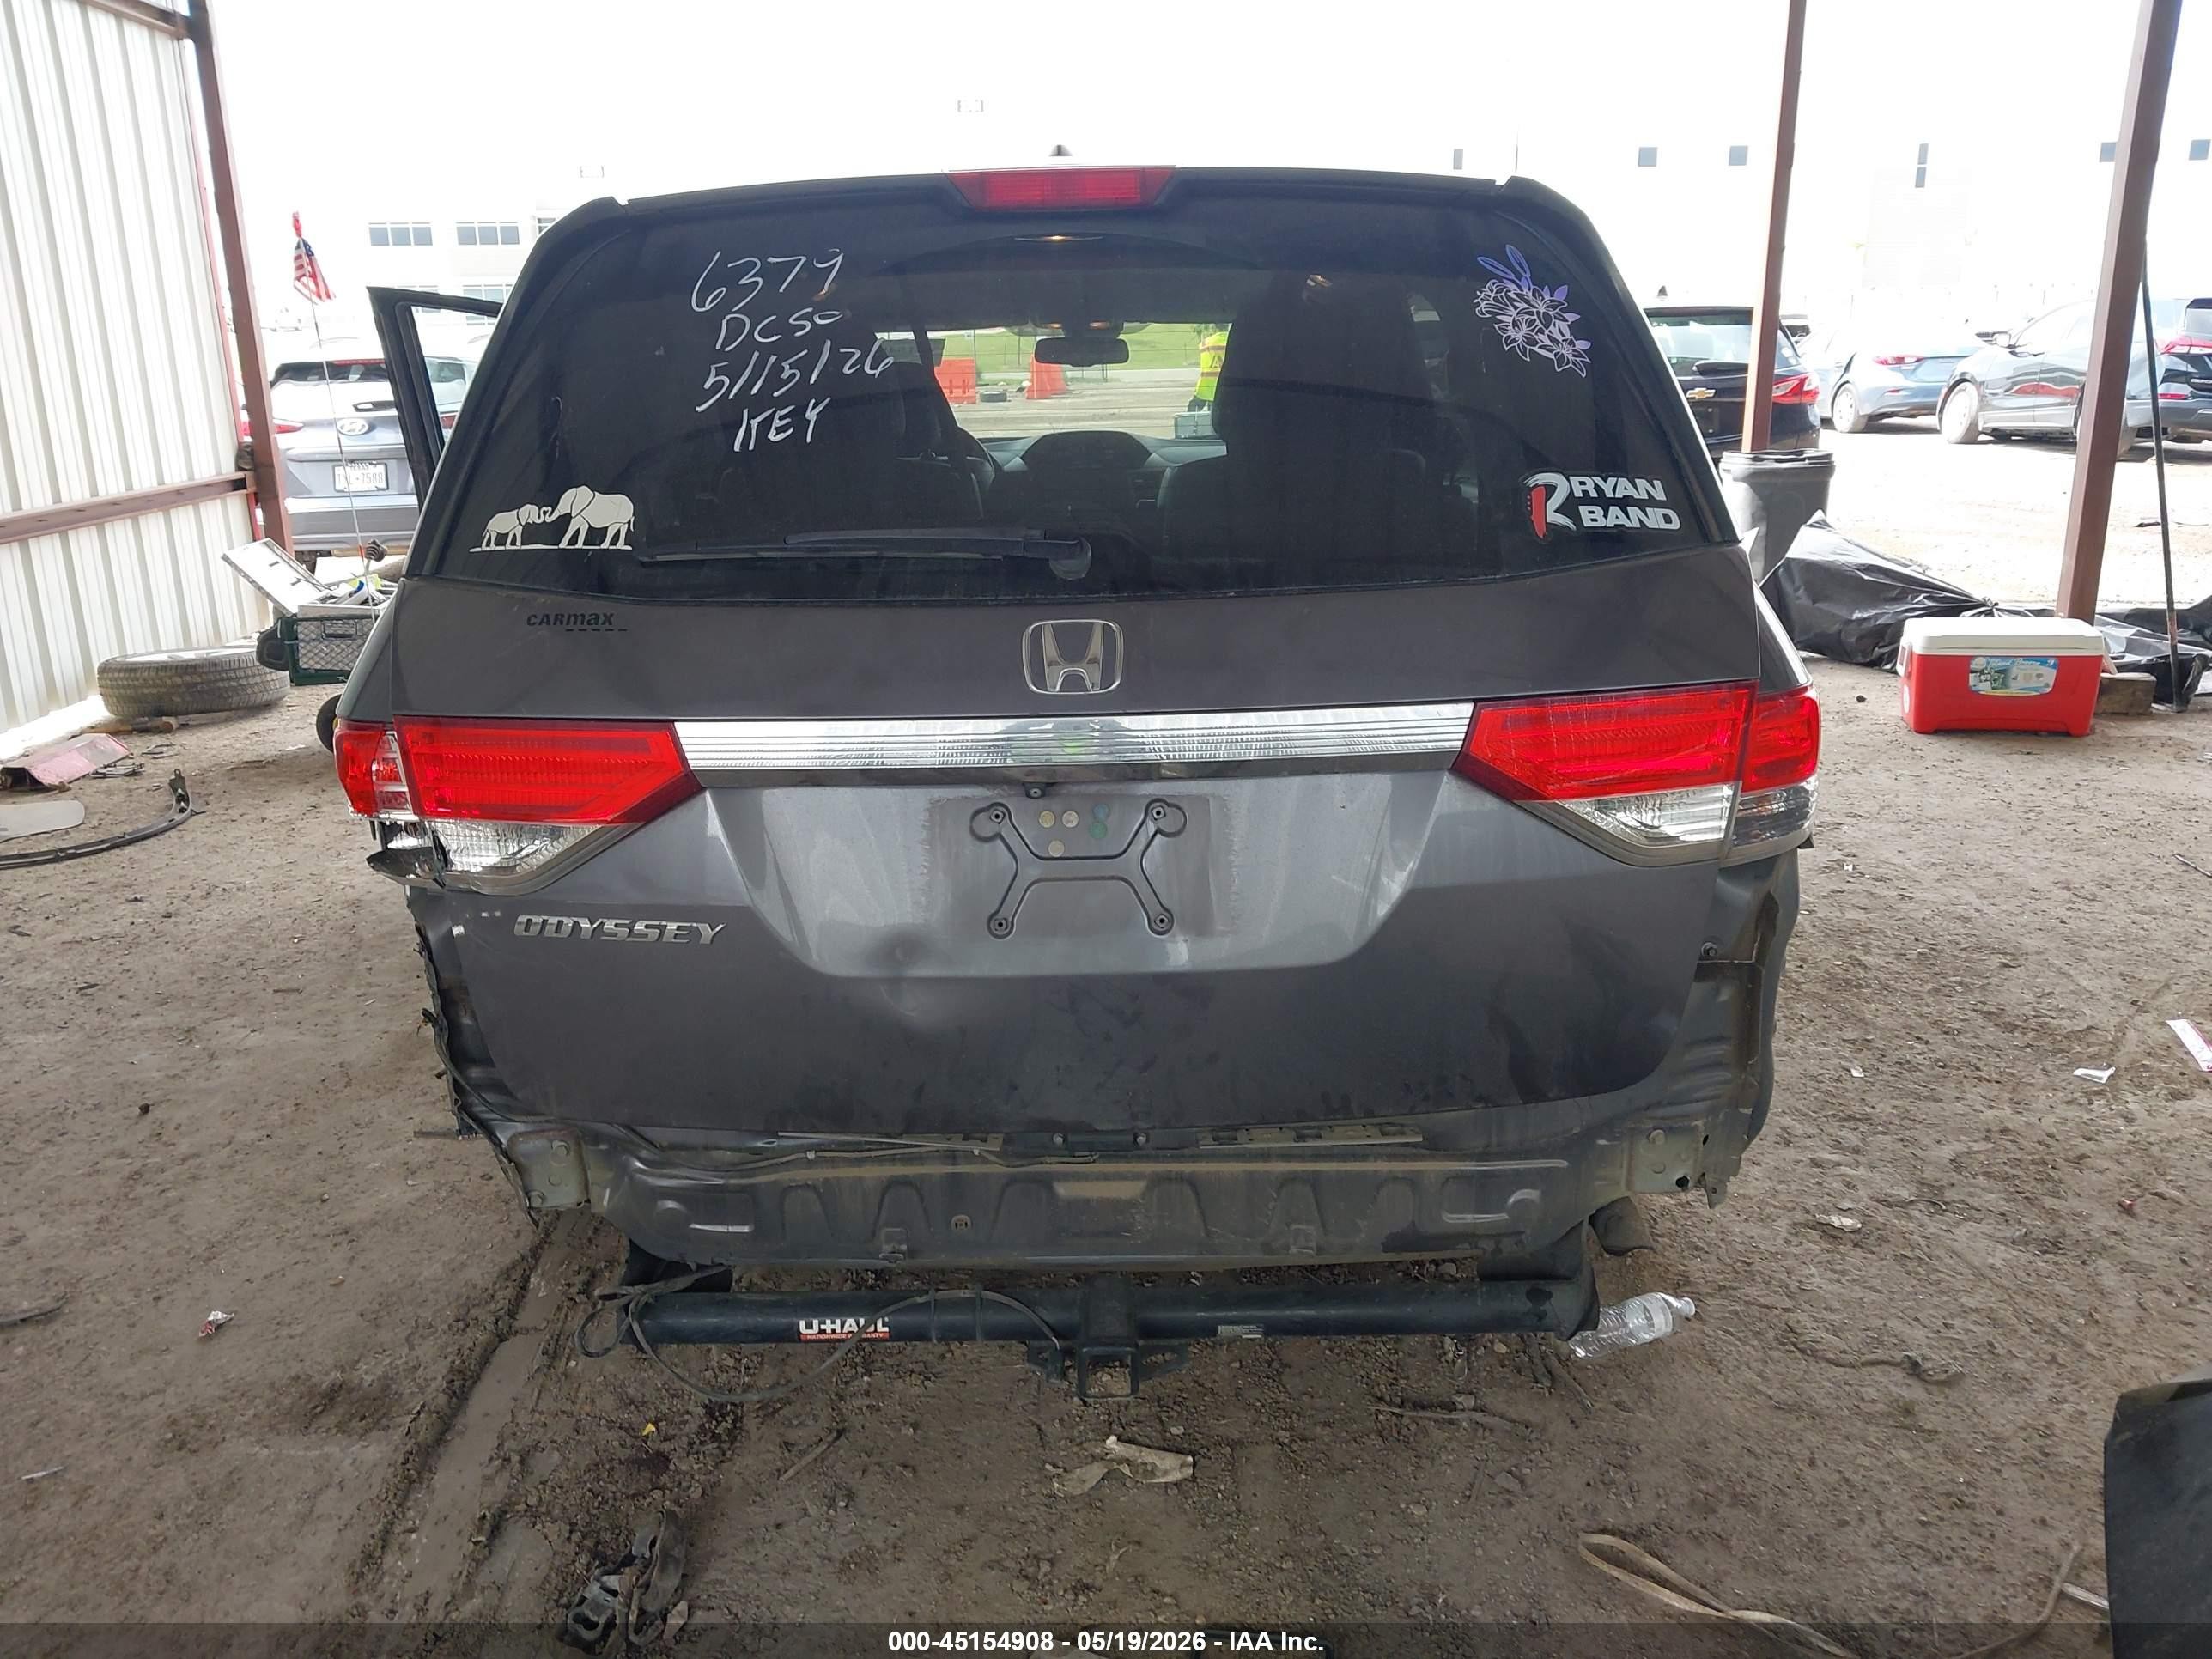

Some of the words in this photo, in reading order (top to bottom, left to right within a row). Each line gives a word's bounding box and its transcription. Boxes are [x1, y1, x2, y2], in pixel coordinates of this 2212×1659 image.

[691, 248, 844, 312] 6379
[695, 339, 894, 412] 5/15/26
[733, 397, 831, 452] KEY
[1569, 476, 1668, 501] RYAN
[1577, 504, 1681, 530] BAND
[514, 914, 726, 945] ODYSSEY
